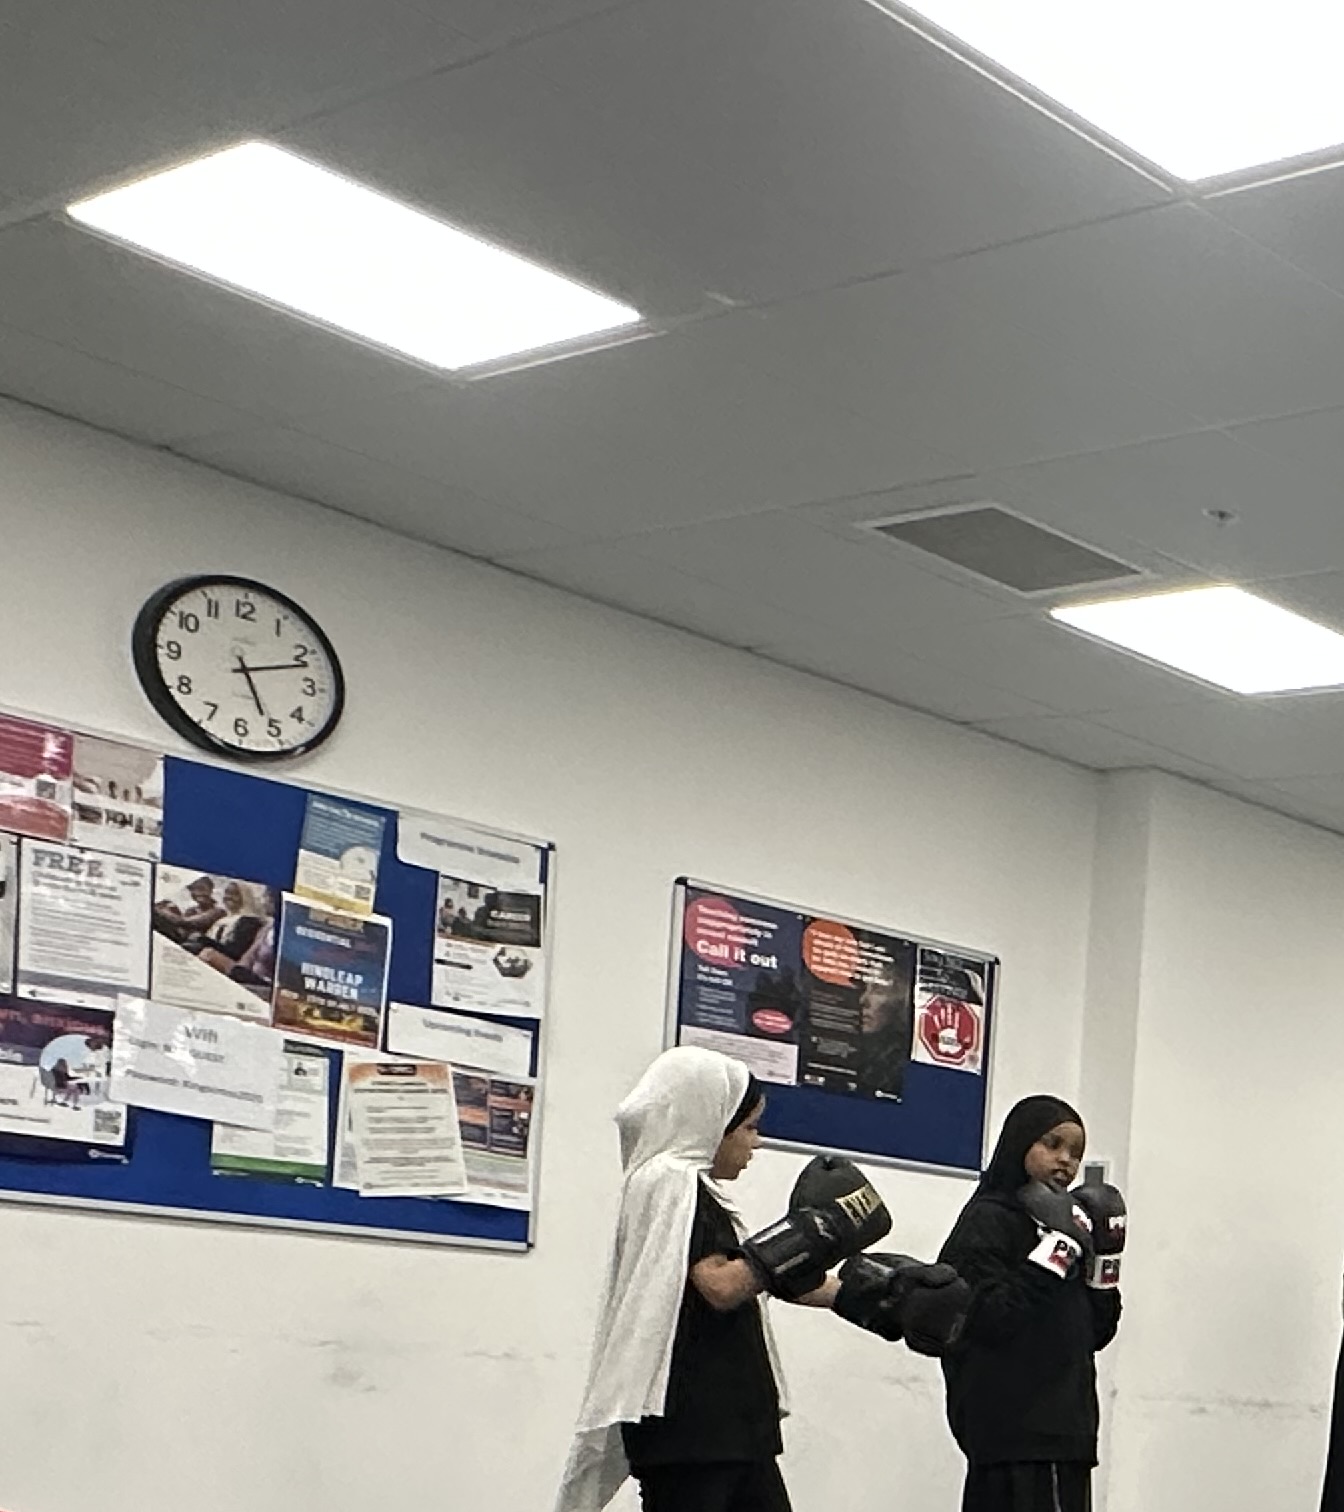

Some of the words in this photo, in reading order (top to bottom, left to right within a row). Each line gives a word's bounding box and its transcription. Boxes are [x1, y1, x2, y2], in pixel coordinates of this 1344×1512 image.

[207, 598, 219, 619] 11
[235, 599, 257, 623] 12
[178, 611, 199, 633] 10
[274, 618, 281, 637] 1
[166, 641, 181, 660] 9
[293, 645, 308, 667] 2
[177, 675, 192, 695] 8
[302, 677, 316, 697] 3
[203, 701, 218, 721] 7
[290, 706, 305, 723] 4
[234, 718, 249, 737] 6
[267, 718, 282, 737] 5
[32, 848, 104, 877] FREE
[697, 940, 729, 959] Call
[733, 946, 746, 962] it
[750, 954, 778, 969] out
